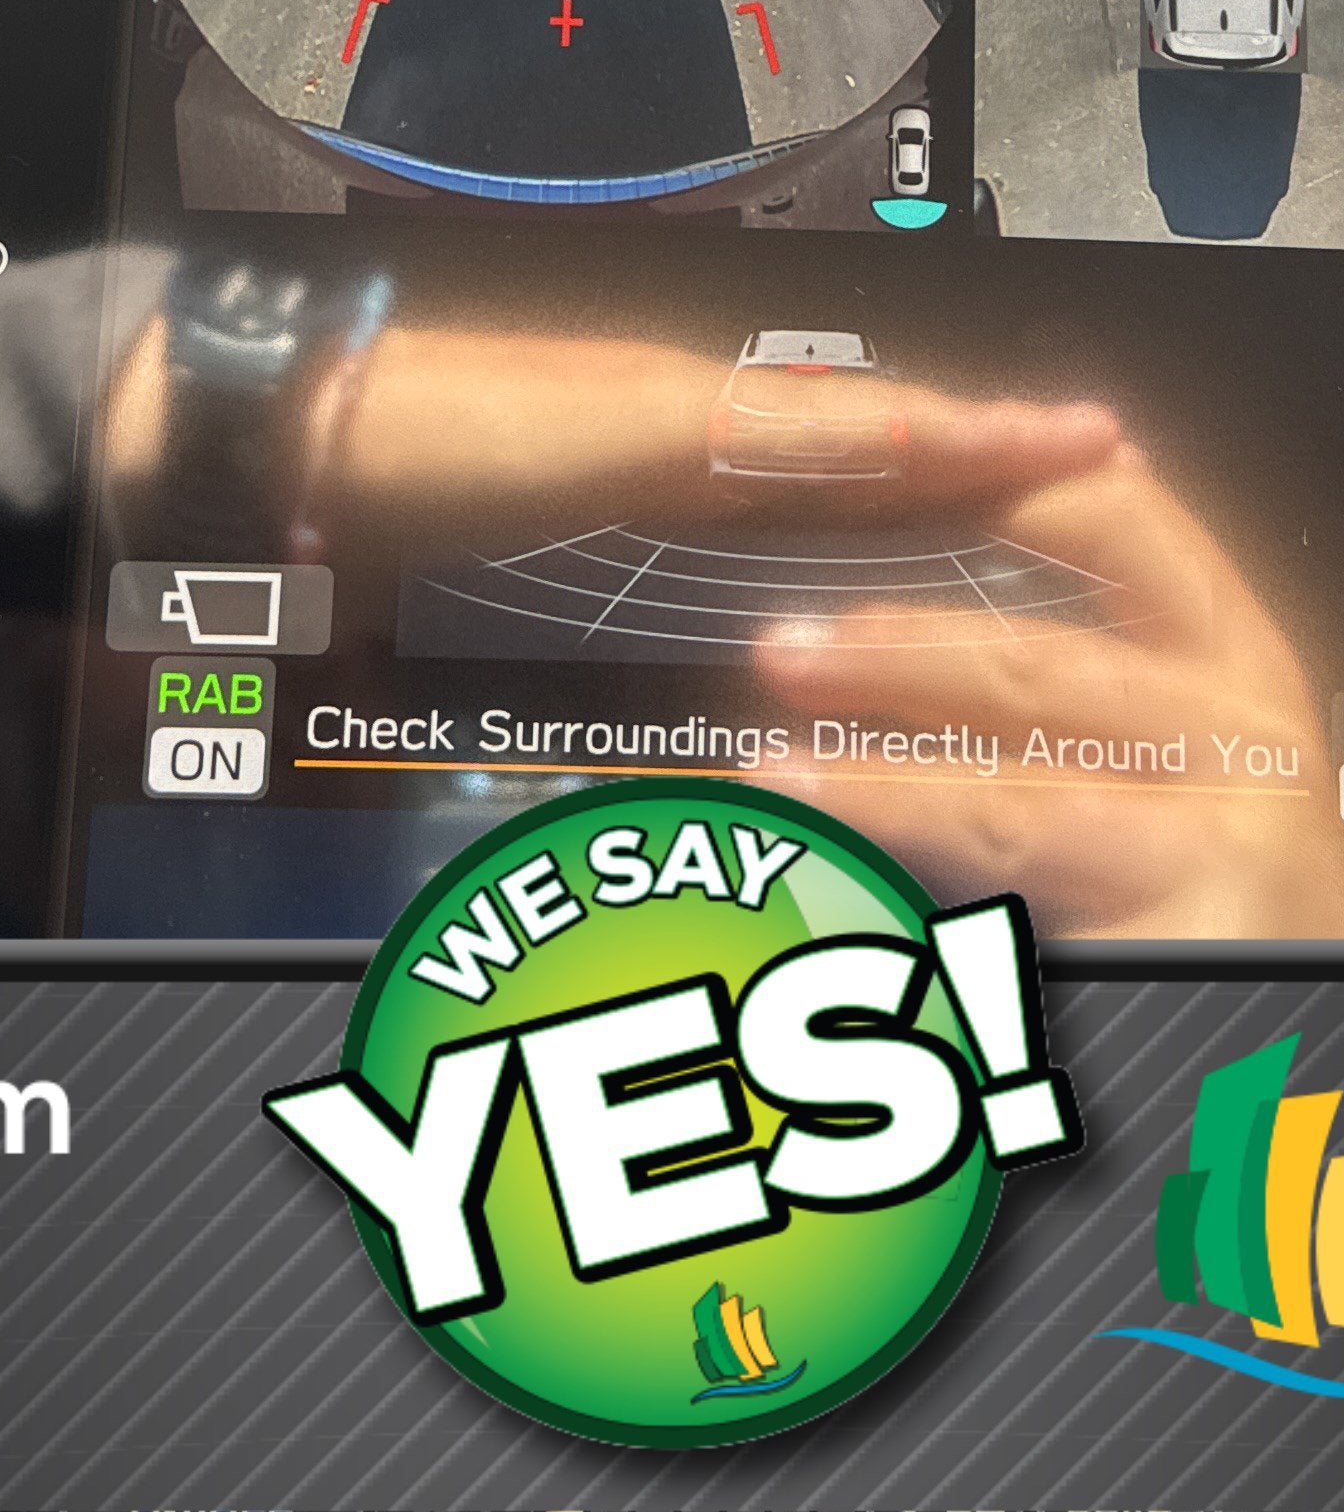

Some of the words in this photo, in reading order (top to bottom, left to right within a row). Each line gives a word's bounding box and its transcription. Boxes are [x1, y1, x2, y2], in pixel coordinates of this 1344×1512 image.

[158, 672, 263, 714] RAB
[171, 739, 243, 781] ON
[306, 706, 455, 753] Check
[477, 708, 791, 766] Surroundings
[812, 720, 999, 775] Directly
[1020, 728, 1187, 773] Around
[1210, 736, 1302, 778] You
